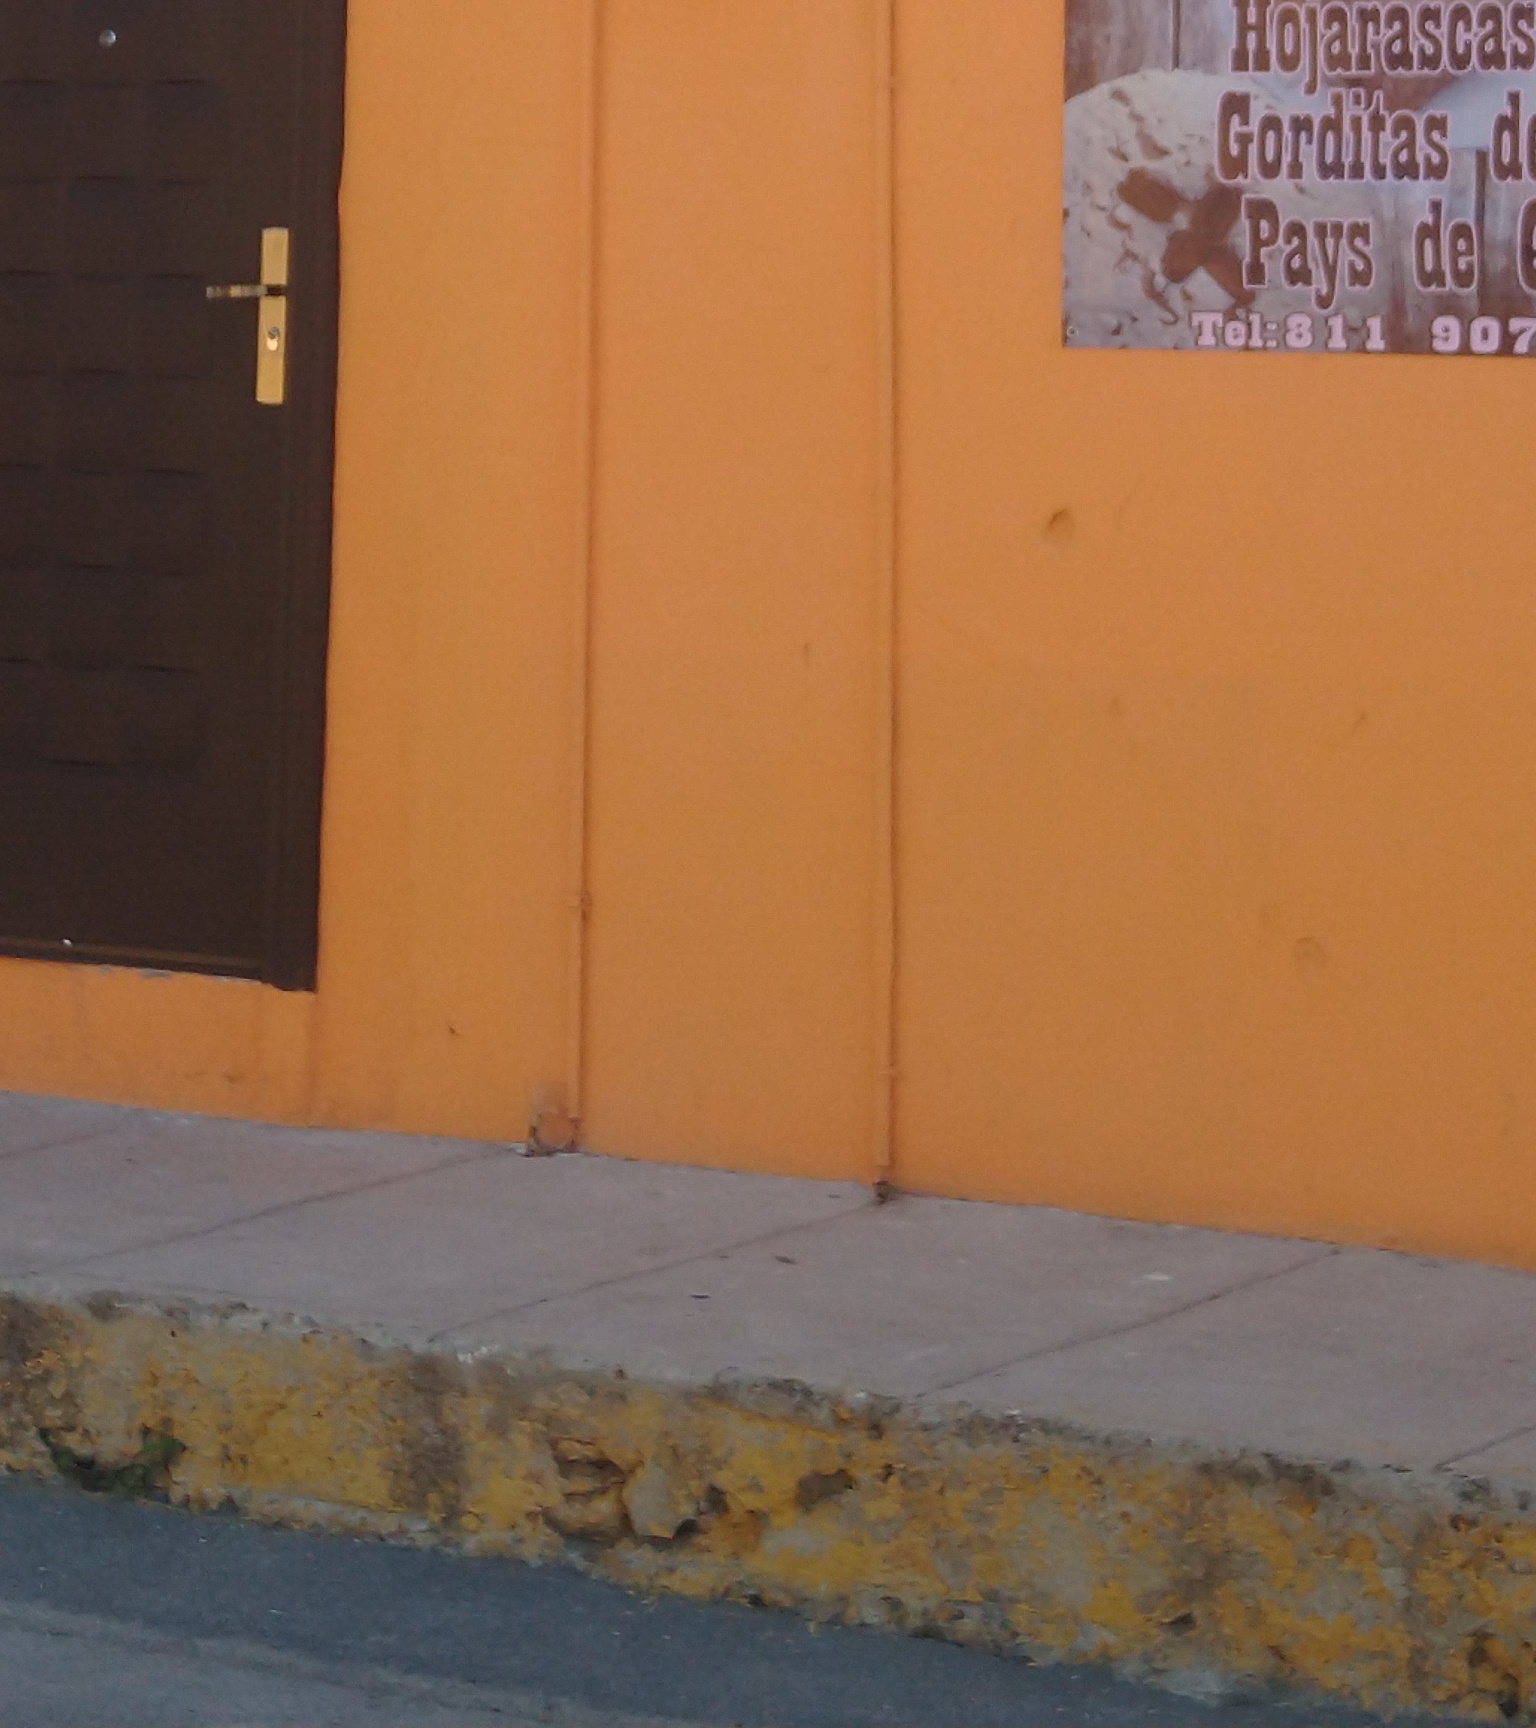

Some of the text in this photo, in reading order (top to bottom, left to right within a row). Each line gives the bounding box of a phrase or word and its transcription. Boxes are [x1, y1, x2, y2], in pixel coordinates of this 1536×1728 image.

[1215, 88, 1451, 184] Gorditas
[1242, 195, 1375, 310] Pays
[1413, 195, 1481, 292] de
